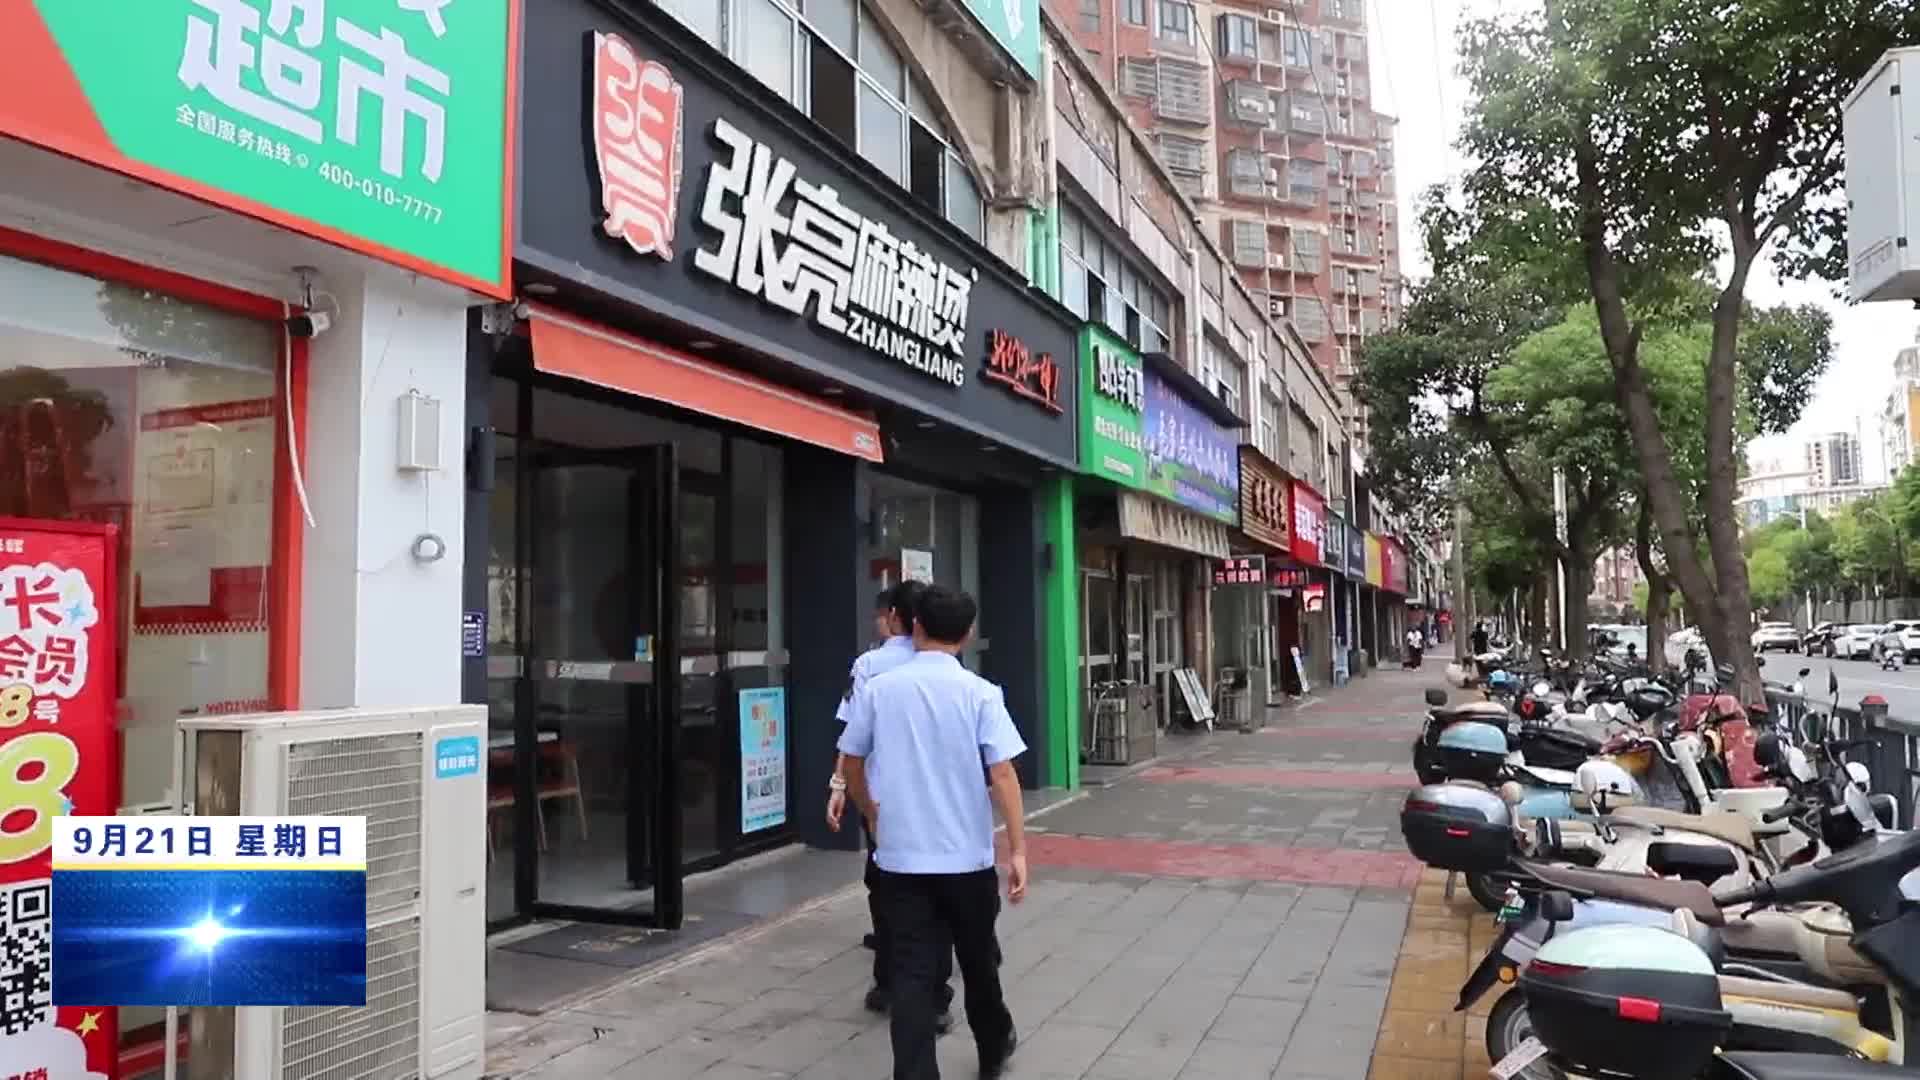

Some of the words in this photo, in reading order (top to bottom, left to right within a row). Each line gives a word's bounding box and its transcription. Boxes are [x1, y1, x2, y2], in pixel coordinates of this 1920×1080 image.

[177, 0, 450, 184] 超市
[176, 103, 292, 166] 全国服务热线
[319, 161, 442, 224] 400-010-7777
[694, 117, 972, 356] 张亮麻辣烫
[847, 311, 964, 386] ZHANGLIANG
[0, 634, 77, 686] 会员
